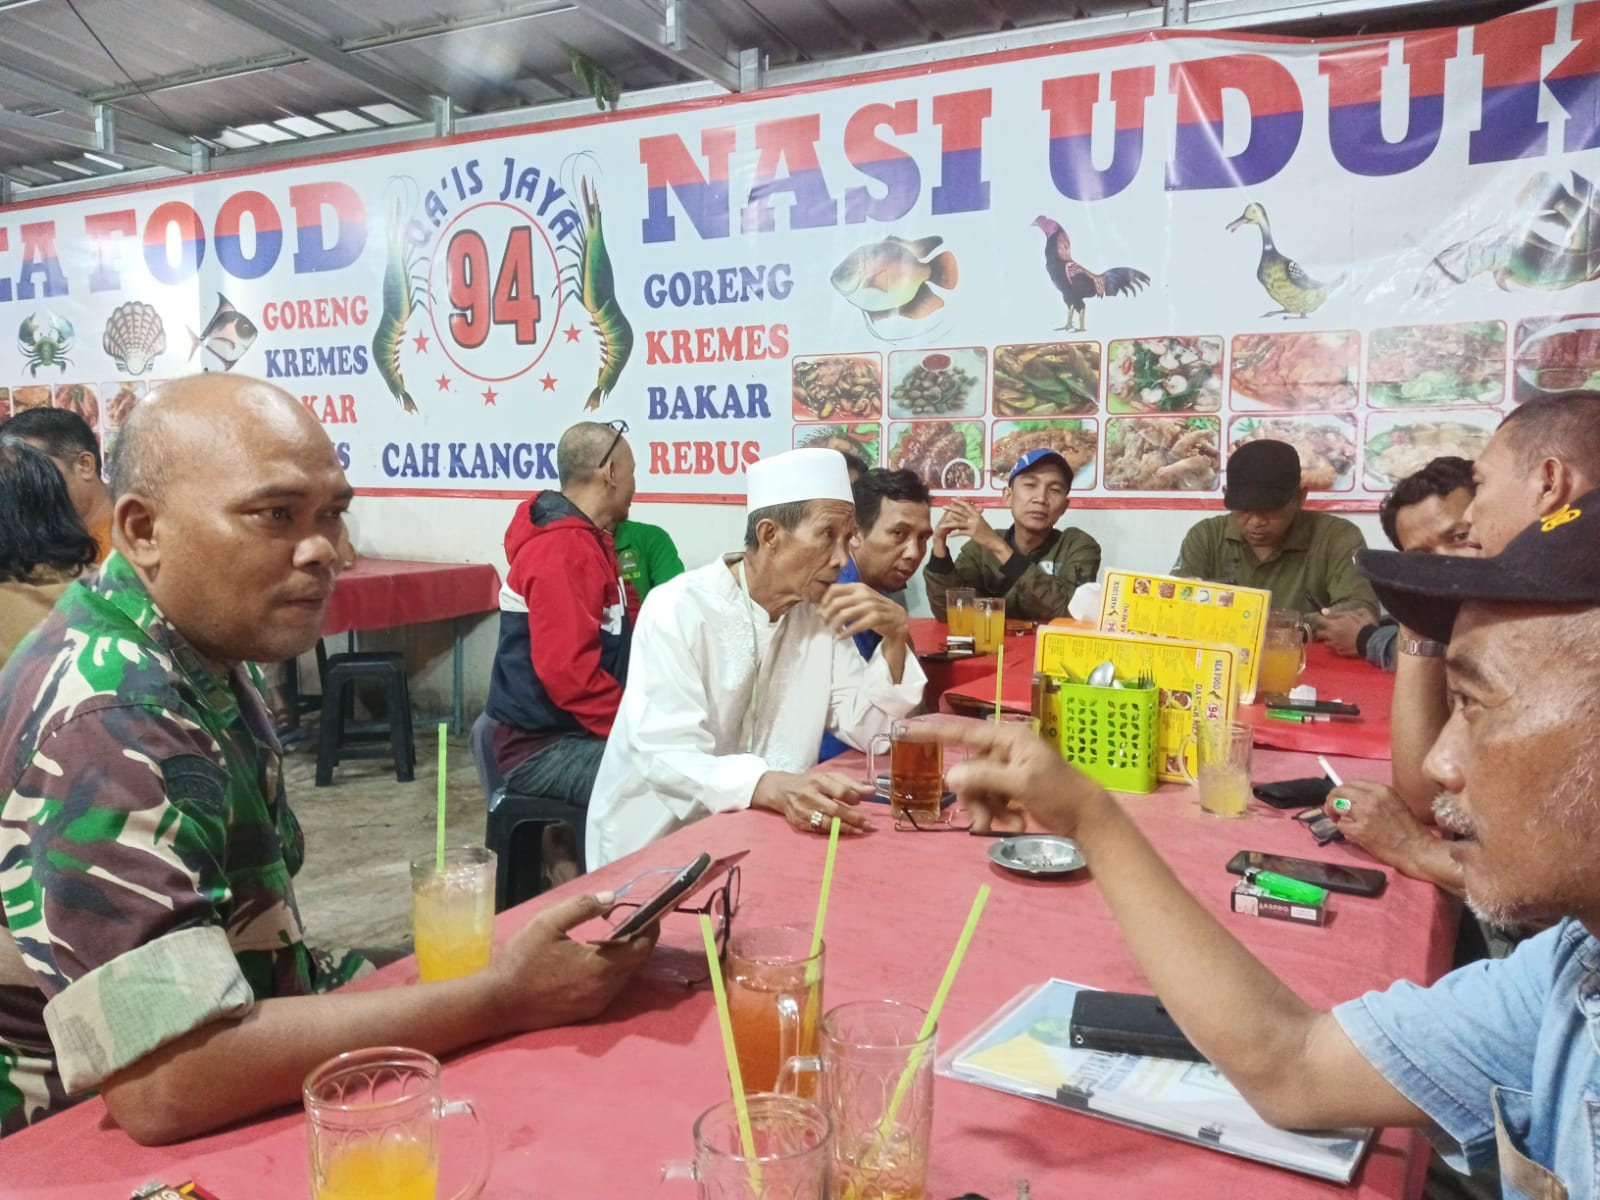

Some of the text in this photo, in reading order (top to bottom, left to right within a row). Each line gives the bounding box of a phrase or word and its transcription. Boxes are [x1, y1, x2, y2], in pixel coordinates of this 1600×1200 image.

[639, 0, 1600, 244] NASI UDUK
[500, 157, 581, 242] JAYA
[0, 181, 369, 302] A FOOD
[446, 225, 541, 349] 94
[644, 263, 794, 309] GORENG
[262, 295, 369, 331] GORENG
[264, 345, 369, 378] KREMES
[645, 323, 790, 365] KREMES
[301, 394, 358, 424] KAR
[647, 383, 771, 421] BAKAR
[382, 442, 440, 477] CAH
[448, 442, 558, 480] KANGK
[649, 440, 760, 475] REBUS
[1208, 705, 1219, 719] 94
